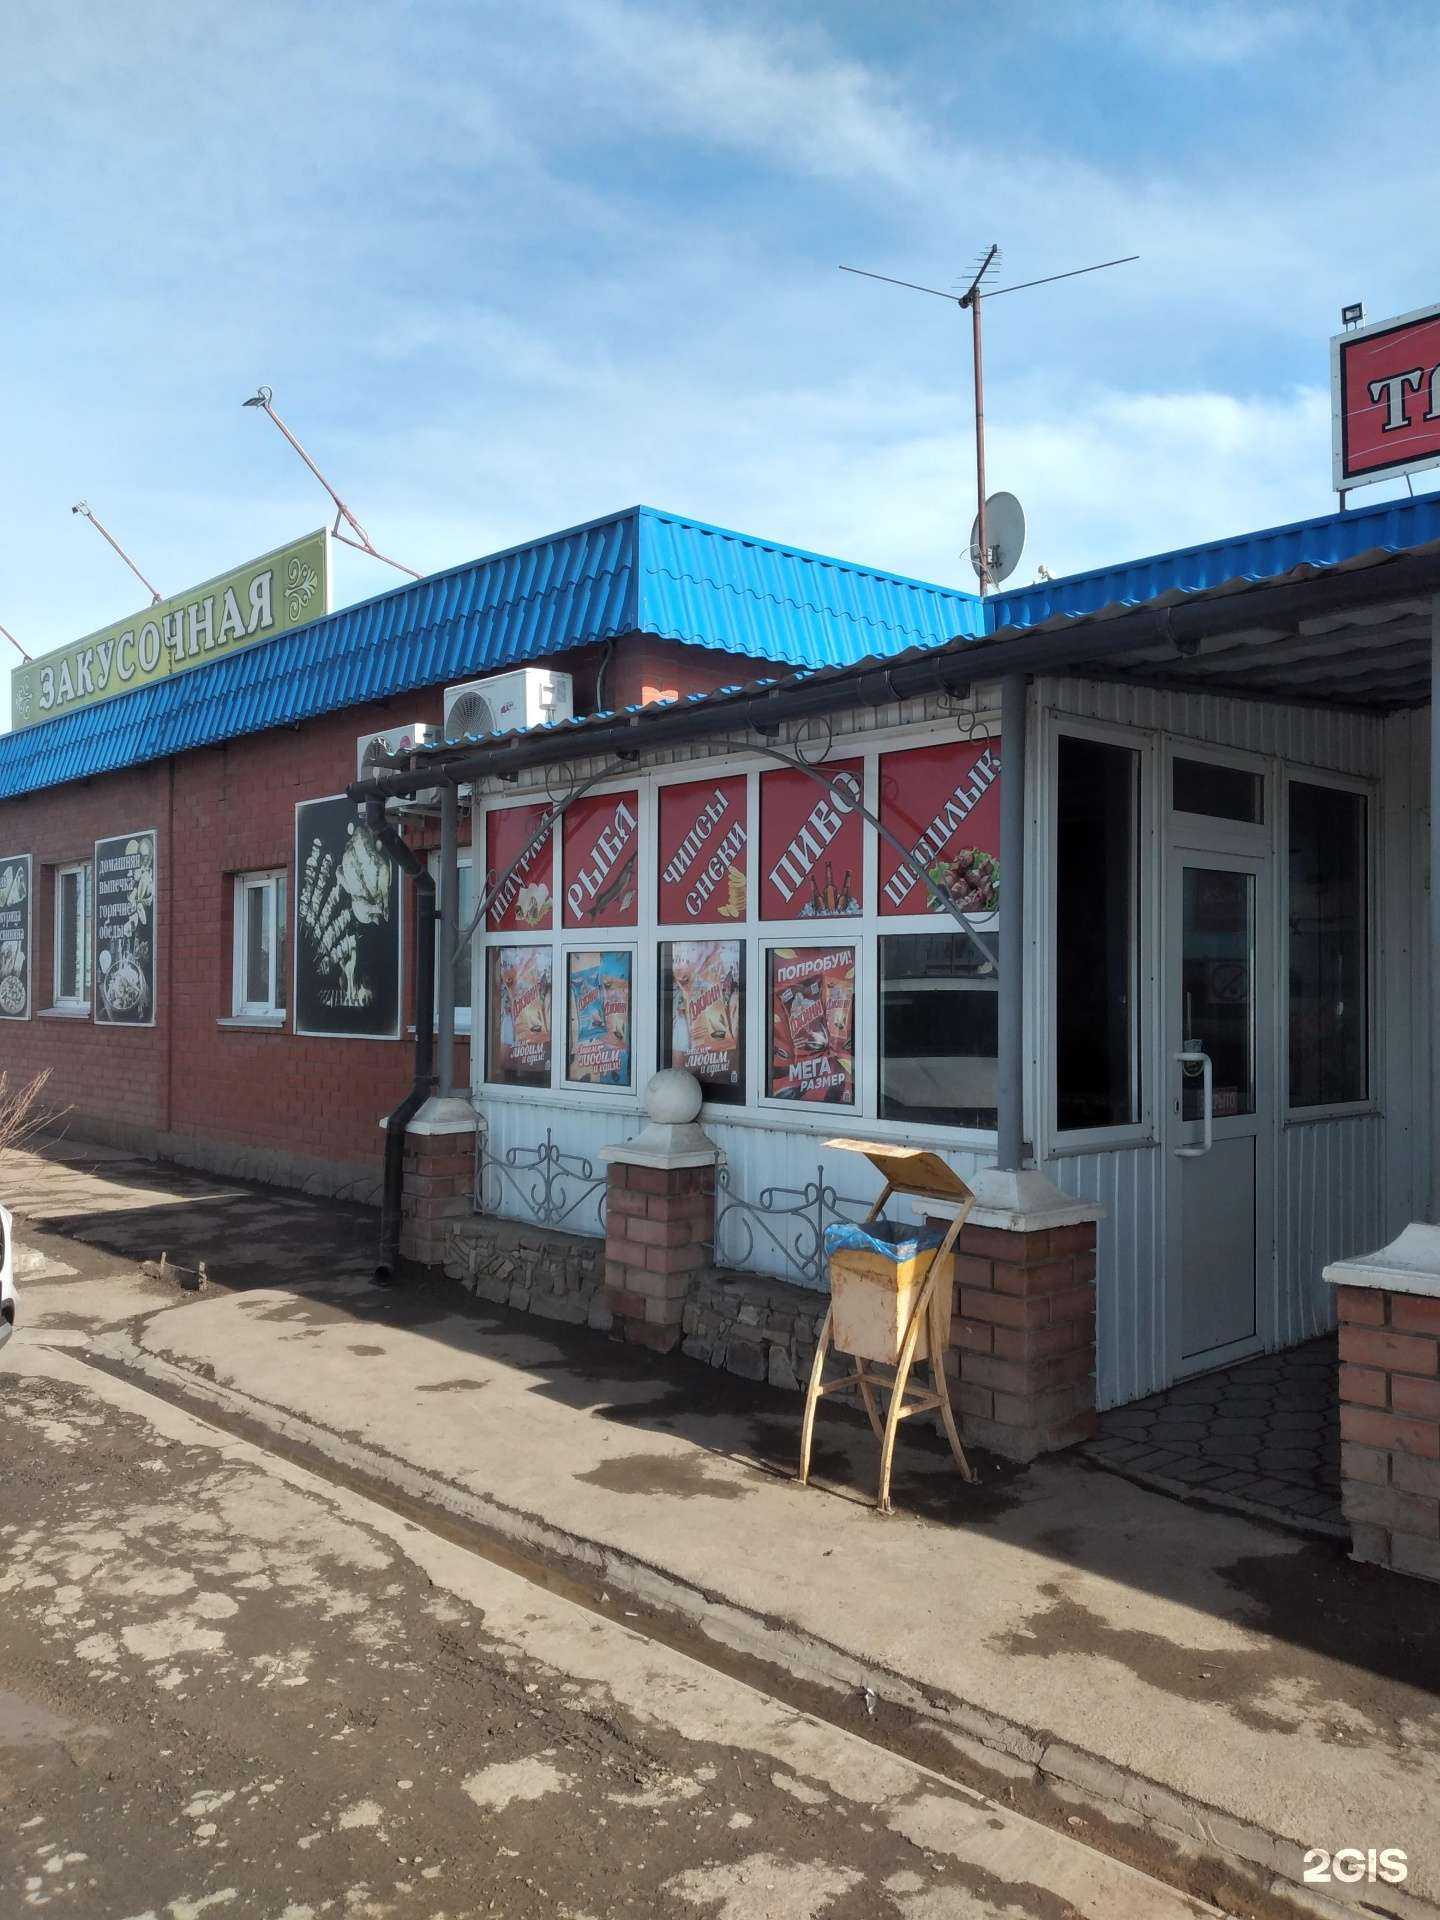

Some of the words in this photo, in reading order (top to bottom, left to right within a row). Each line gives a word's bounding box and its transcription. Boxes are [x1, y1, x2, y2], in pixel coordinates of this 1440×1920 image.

[39, 569, 274, 710] ЗАКУСОЧНАЯ
[566, 800, 638, 920] РЫБА
[661, 788, 729, 885] ЧИПСЫ
[685, 821, 747, 916] СНЕКИ
[768, 772, 862, 904] ПИВО
[788, 1057, 832, 1082] МЕГА
[800, 1074, 846, 1092] РАЗМЕР
